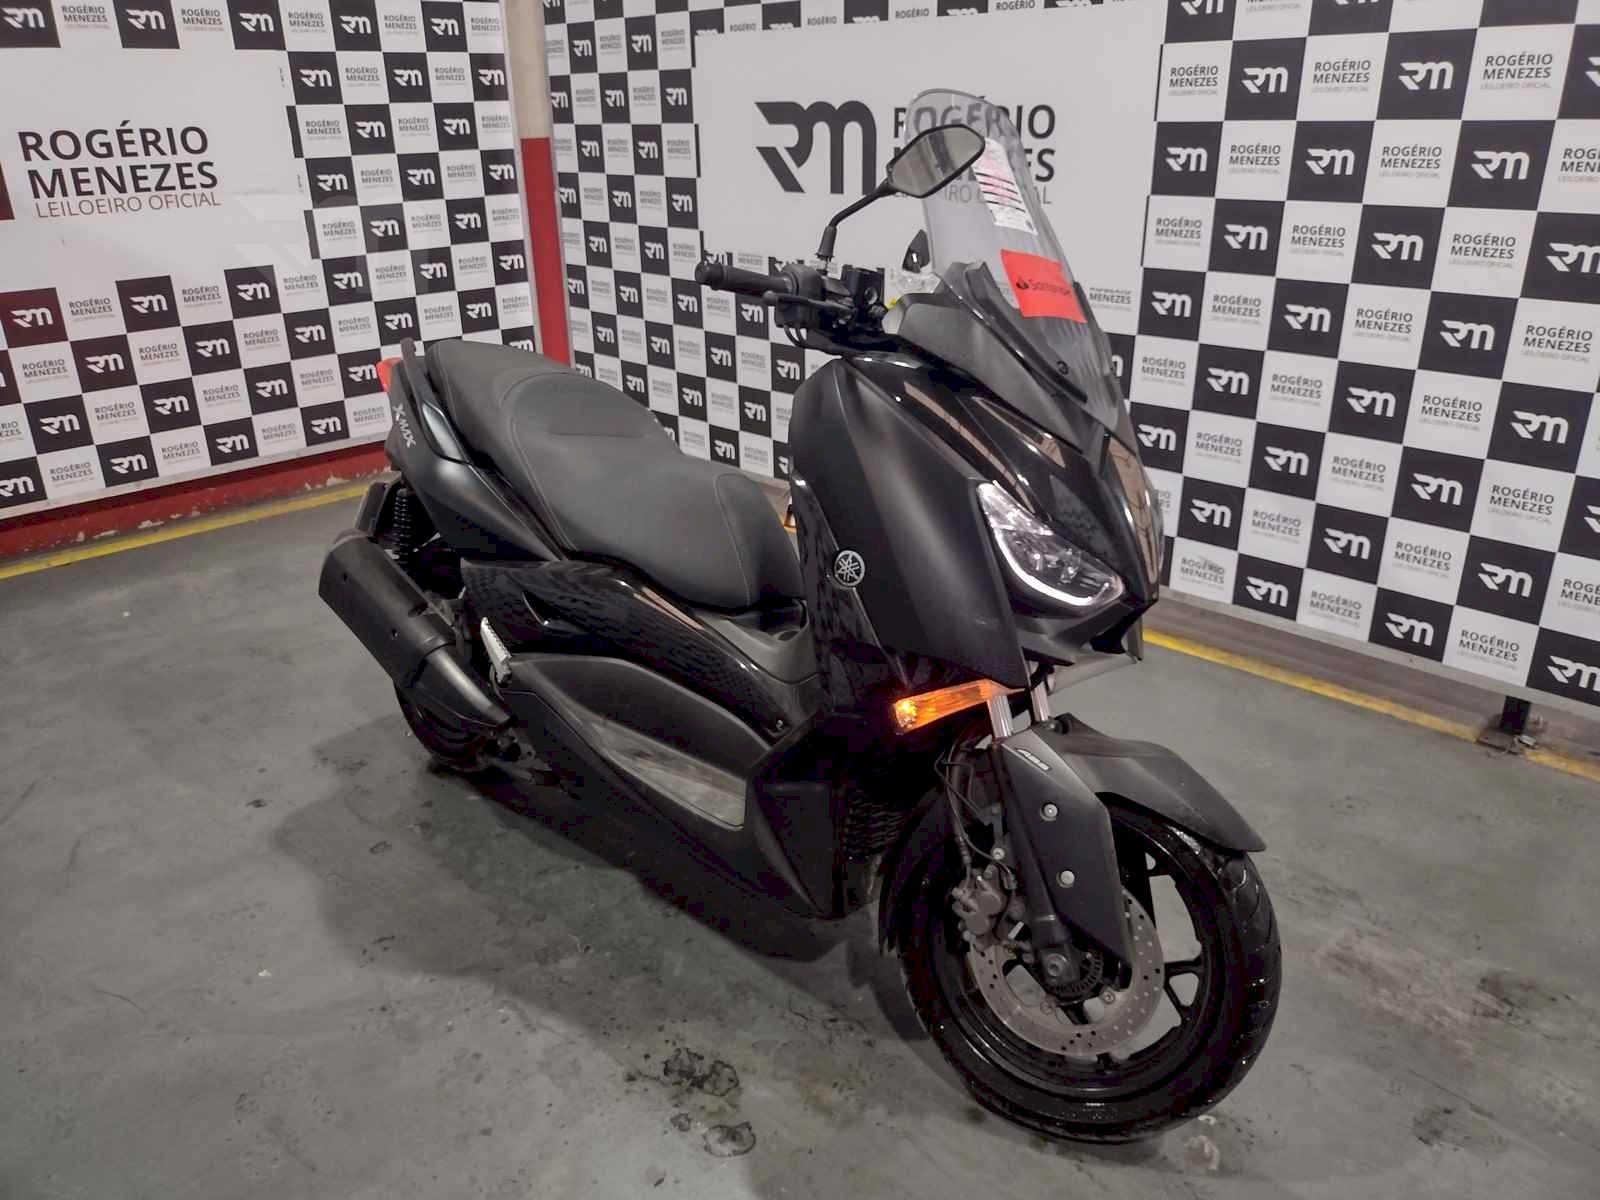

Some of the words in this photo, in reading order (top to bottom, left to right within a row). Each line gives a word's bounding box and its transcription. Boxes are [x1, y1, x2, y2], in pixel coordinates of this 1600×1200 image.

[1313, 58, 1371, 73] ROGÉRIO
[1484, 51, 1554, 67] ROGÉRIO
[1312, 71, 1370, 84] MENEZES
[1482, 66, 1552, 80] MENEZES
[18, 120, 208, 161] ROGÉRIO
[1229, 142, 1281, 155] ROGÉRIO
[1381, 143, 1442, 157] ROGÉRIO
[1228, 155, 1280, 166] MENEZES
[1379, 157, 1441, 169] MENEZES
[28, 161, 218, 199] MENEZES
[36, 196, 143, 218] LEILOEIRO
[149, 191, 221, 210] OFICIAL
[1291, 224, 1345, 238] ROGÉRIO
[1451, 232, 1516, 248] ROGÉRIO
[1289, 235, 1345, 248] MENEZES
[1449, 245, 1515, 260] MENEZES
[1355, 308, 1412, 323] ROGÉRIO
[1353, 318, 1411, 334] MENEZES
[1524, 324, 1593, 342] ROGÉRIO
[1522, 336, 1592, 354] MENEZES
[1271, 373, 1322, 389] ROGÉRIO
[1269, 383, 1321, 399] MENEZES
[1421, 394, 1482, 412] ROGÉRIO
[1419, 404, 1481, 423] MENEZES
[1331, 455, 1385, 474] ROGÉRIO
[1330, 465, 1385, 484] MENEZES
[1490, 484, 1555, 505] ROGÉRIO
[1488, 494, 1553, 516] MENEZES
[1394, 540, 1451, 562] ROGÉRIO
[1392, 550, 1450, 572] MENEZES
[1308, 599, 1360, 620] MENEZES
[1310, 590, 1361, 611] ROGÉRIO
[1460, 629, 1520, 653] ROGÉRIO
[1457, 638, 1519, 663] MENEZES
